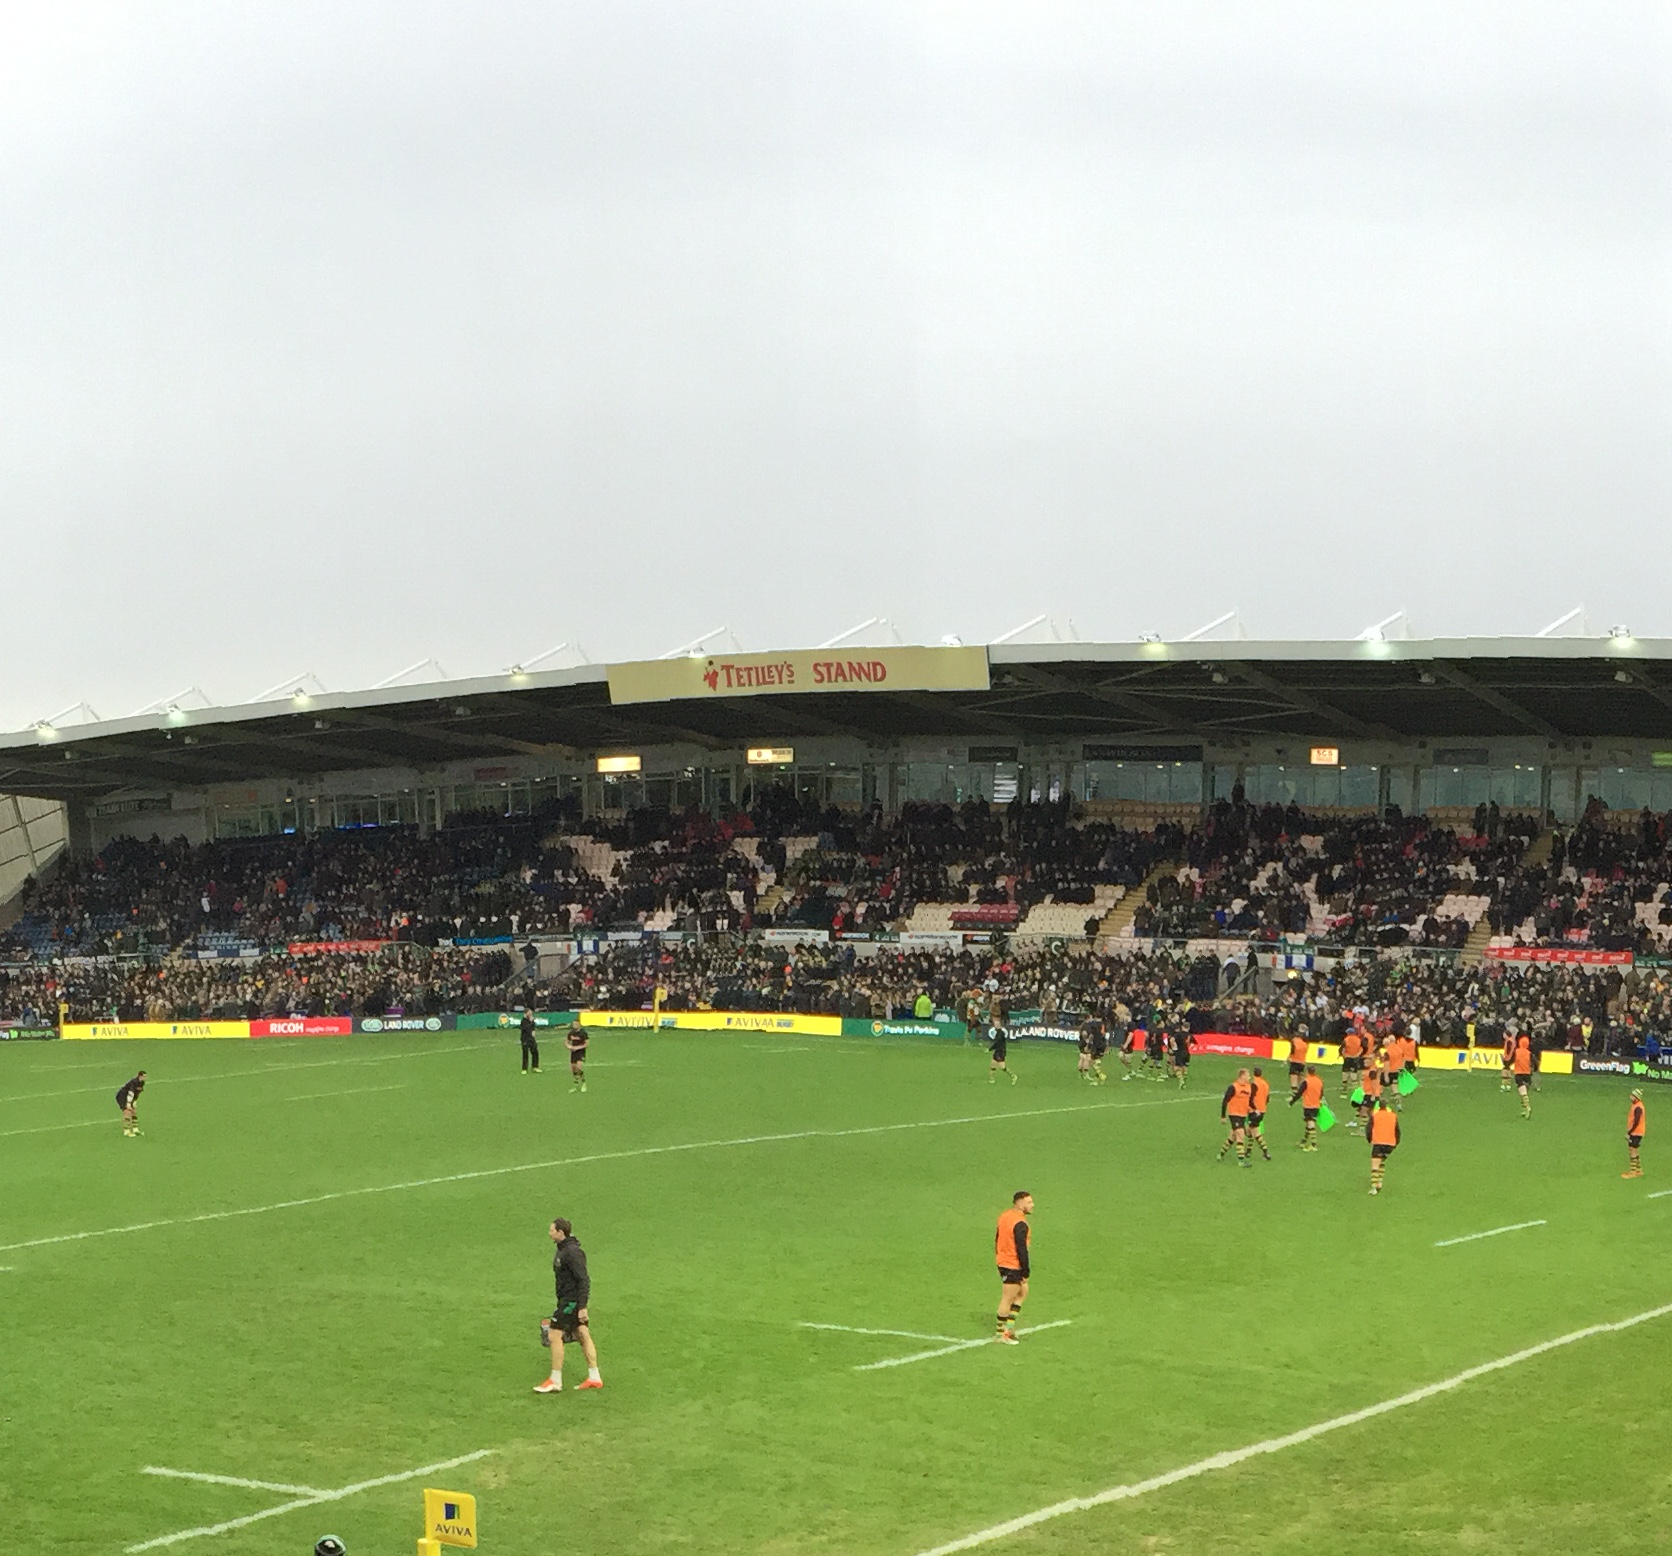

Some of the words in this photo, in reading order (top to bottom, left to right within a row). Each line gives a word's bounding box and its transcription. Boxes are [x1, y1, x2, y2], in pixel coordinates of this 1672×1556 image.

[182, 1025, 212, 1036] AVIVA
[270, 1022, 304, 1034] RICOH
[384, 1020, 402, 1030] LAND
[403, 1020, 424, 1030] ROVER
[101, 1026, 129, 1036] AVIVA
[1471, 1052, 1505, 1065] AVIV
[1648, 1069, 1660, 1079] No
[435, 1523, 472, 1538] AVIVA
